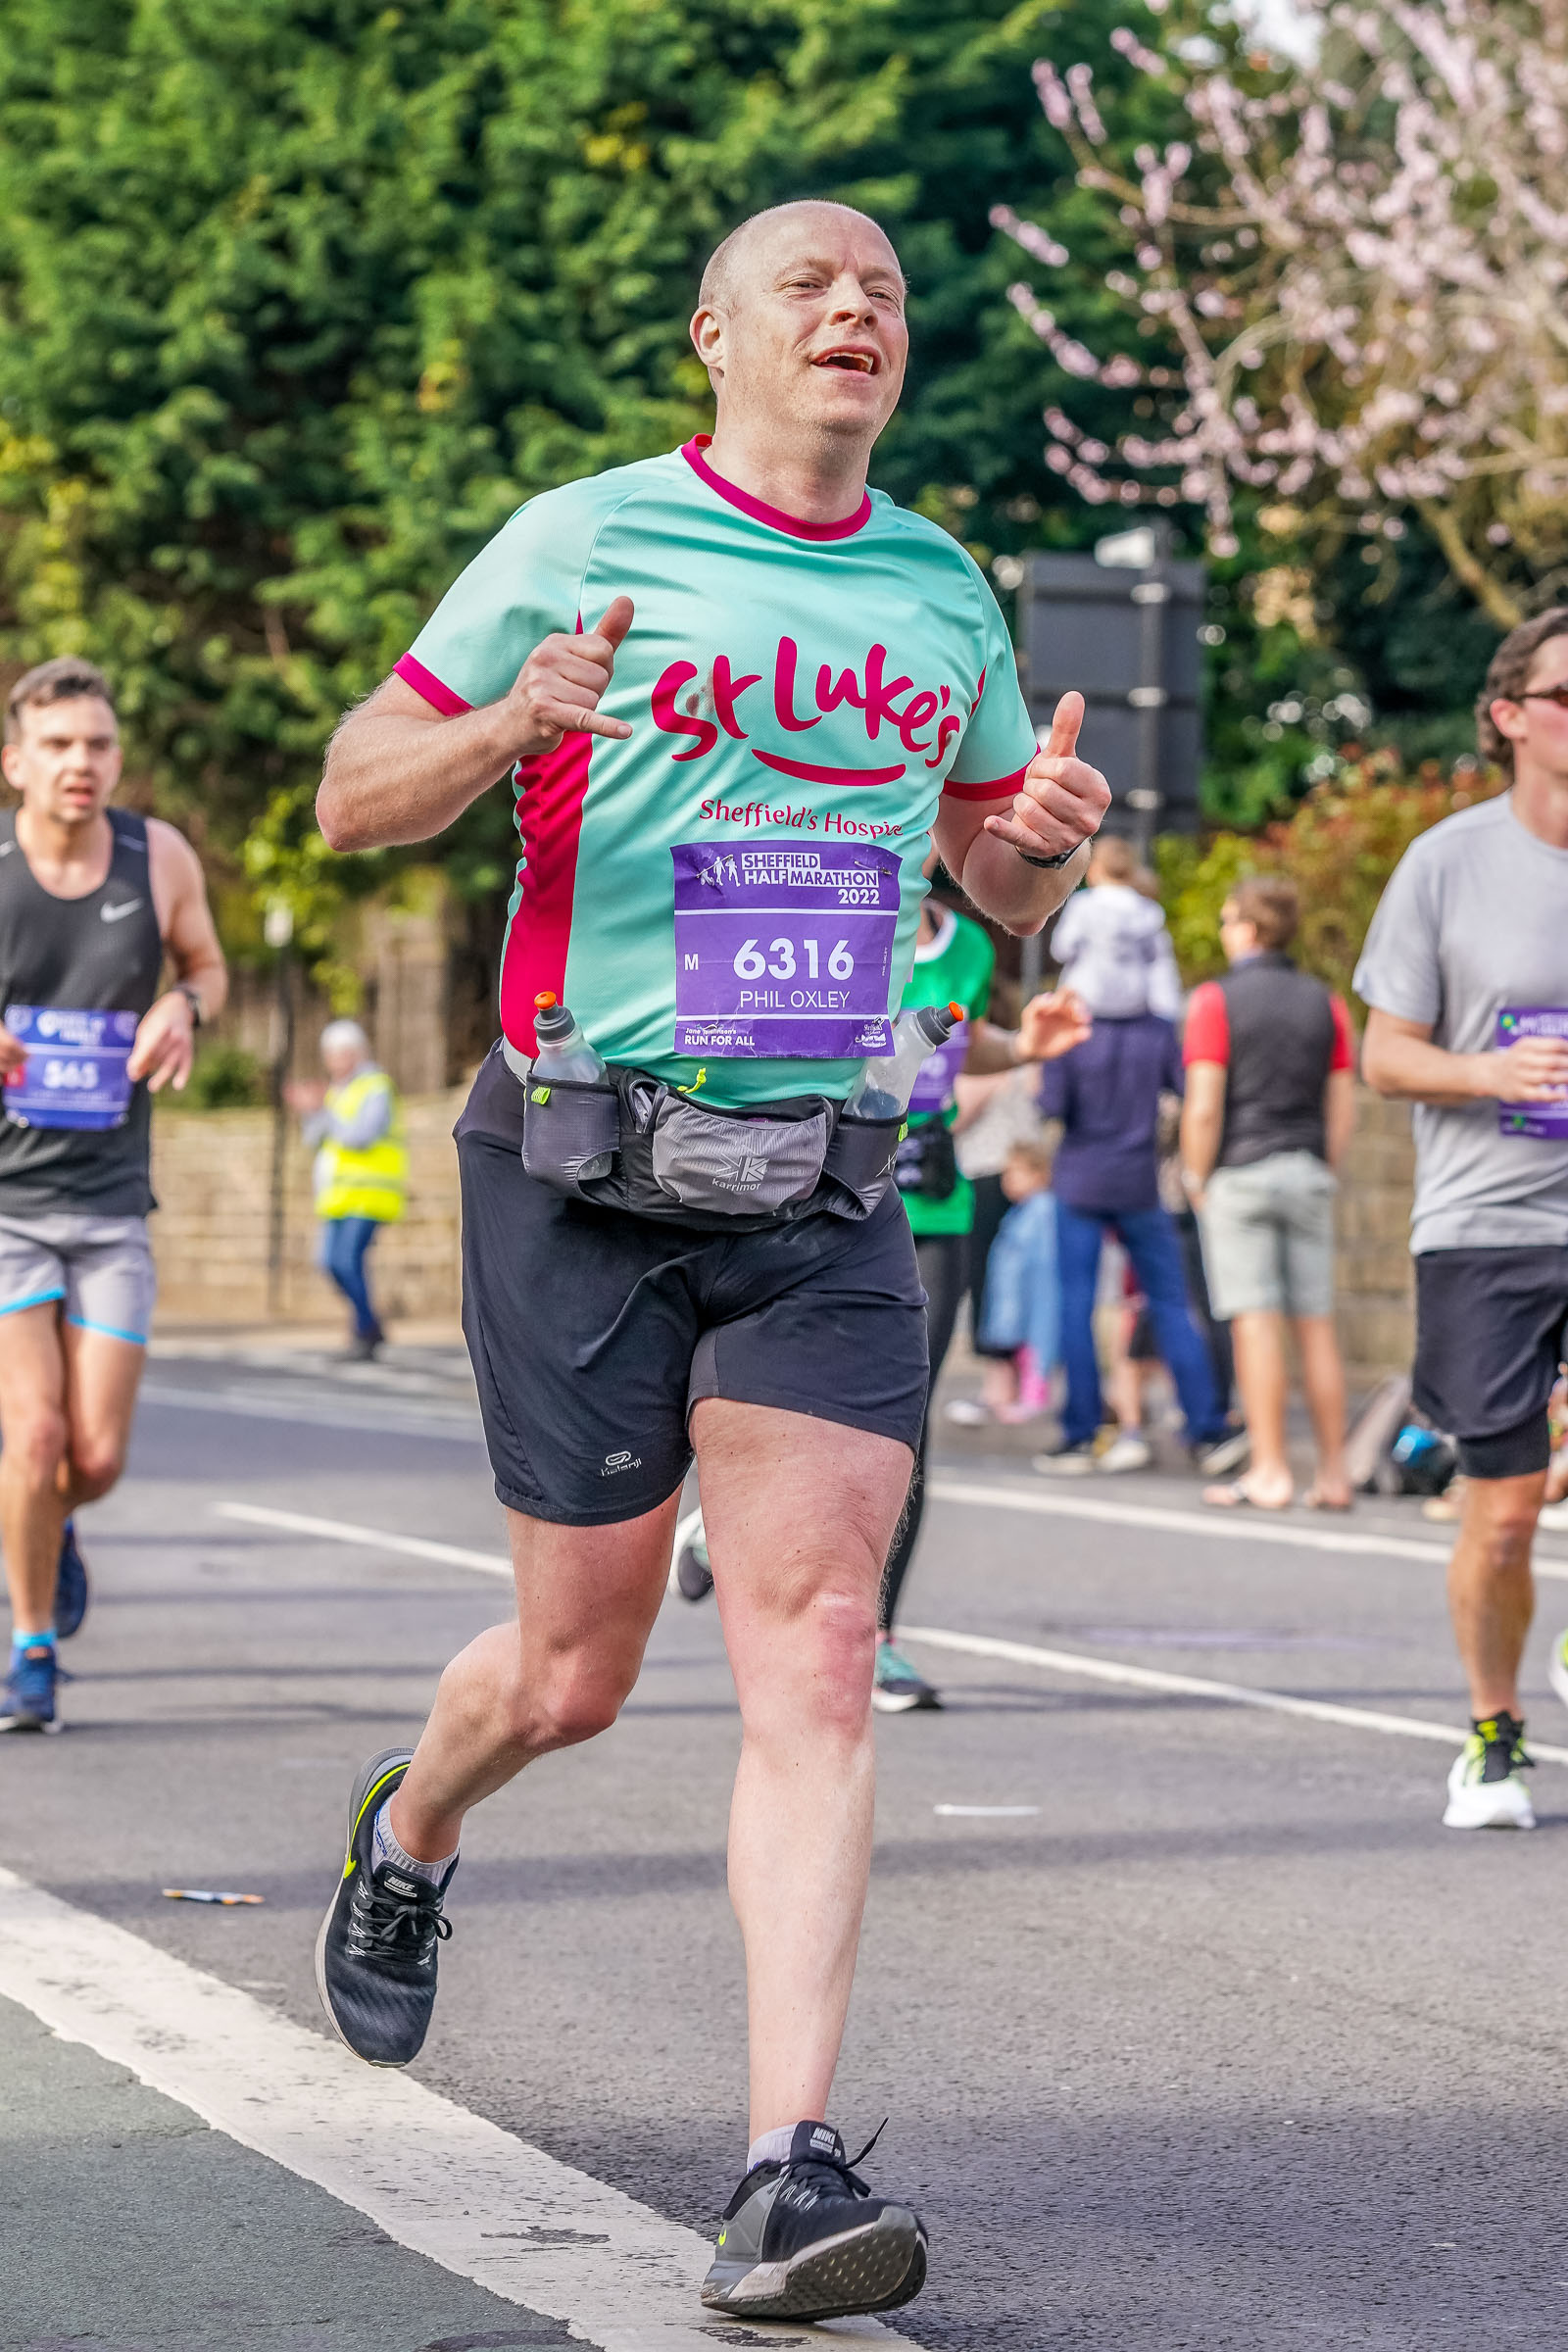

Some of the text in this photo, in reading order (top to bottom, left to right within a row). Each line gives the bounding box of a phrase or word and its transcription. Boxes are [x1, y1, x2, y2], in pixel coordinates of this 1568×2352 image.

[651, 636, 961, 768] St Luke's
[699, 799, 818, 831] Sheffield's
[743, 854, 819, 869] SHEFFIELD
[745, 870, 877, 886] HALF MARATHON
[838, 888, 880, 905] 2022
[685, 937, 855, 980] M 6316
[740, 990, 852, 1008] PHIL OXLEY
[703, 1027, 737, 1036] Tomnson's
[684, 1035, 755, 1046] RUN FOR ALL
[711, 1178, 761, 1192] karrimor
[387, 1876, 416, 1891] NIKE
